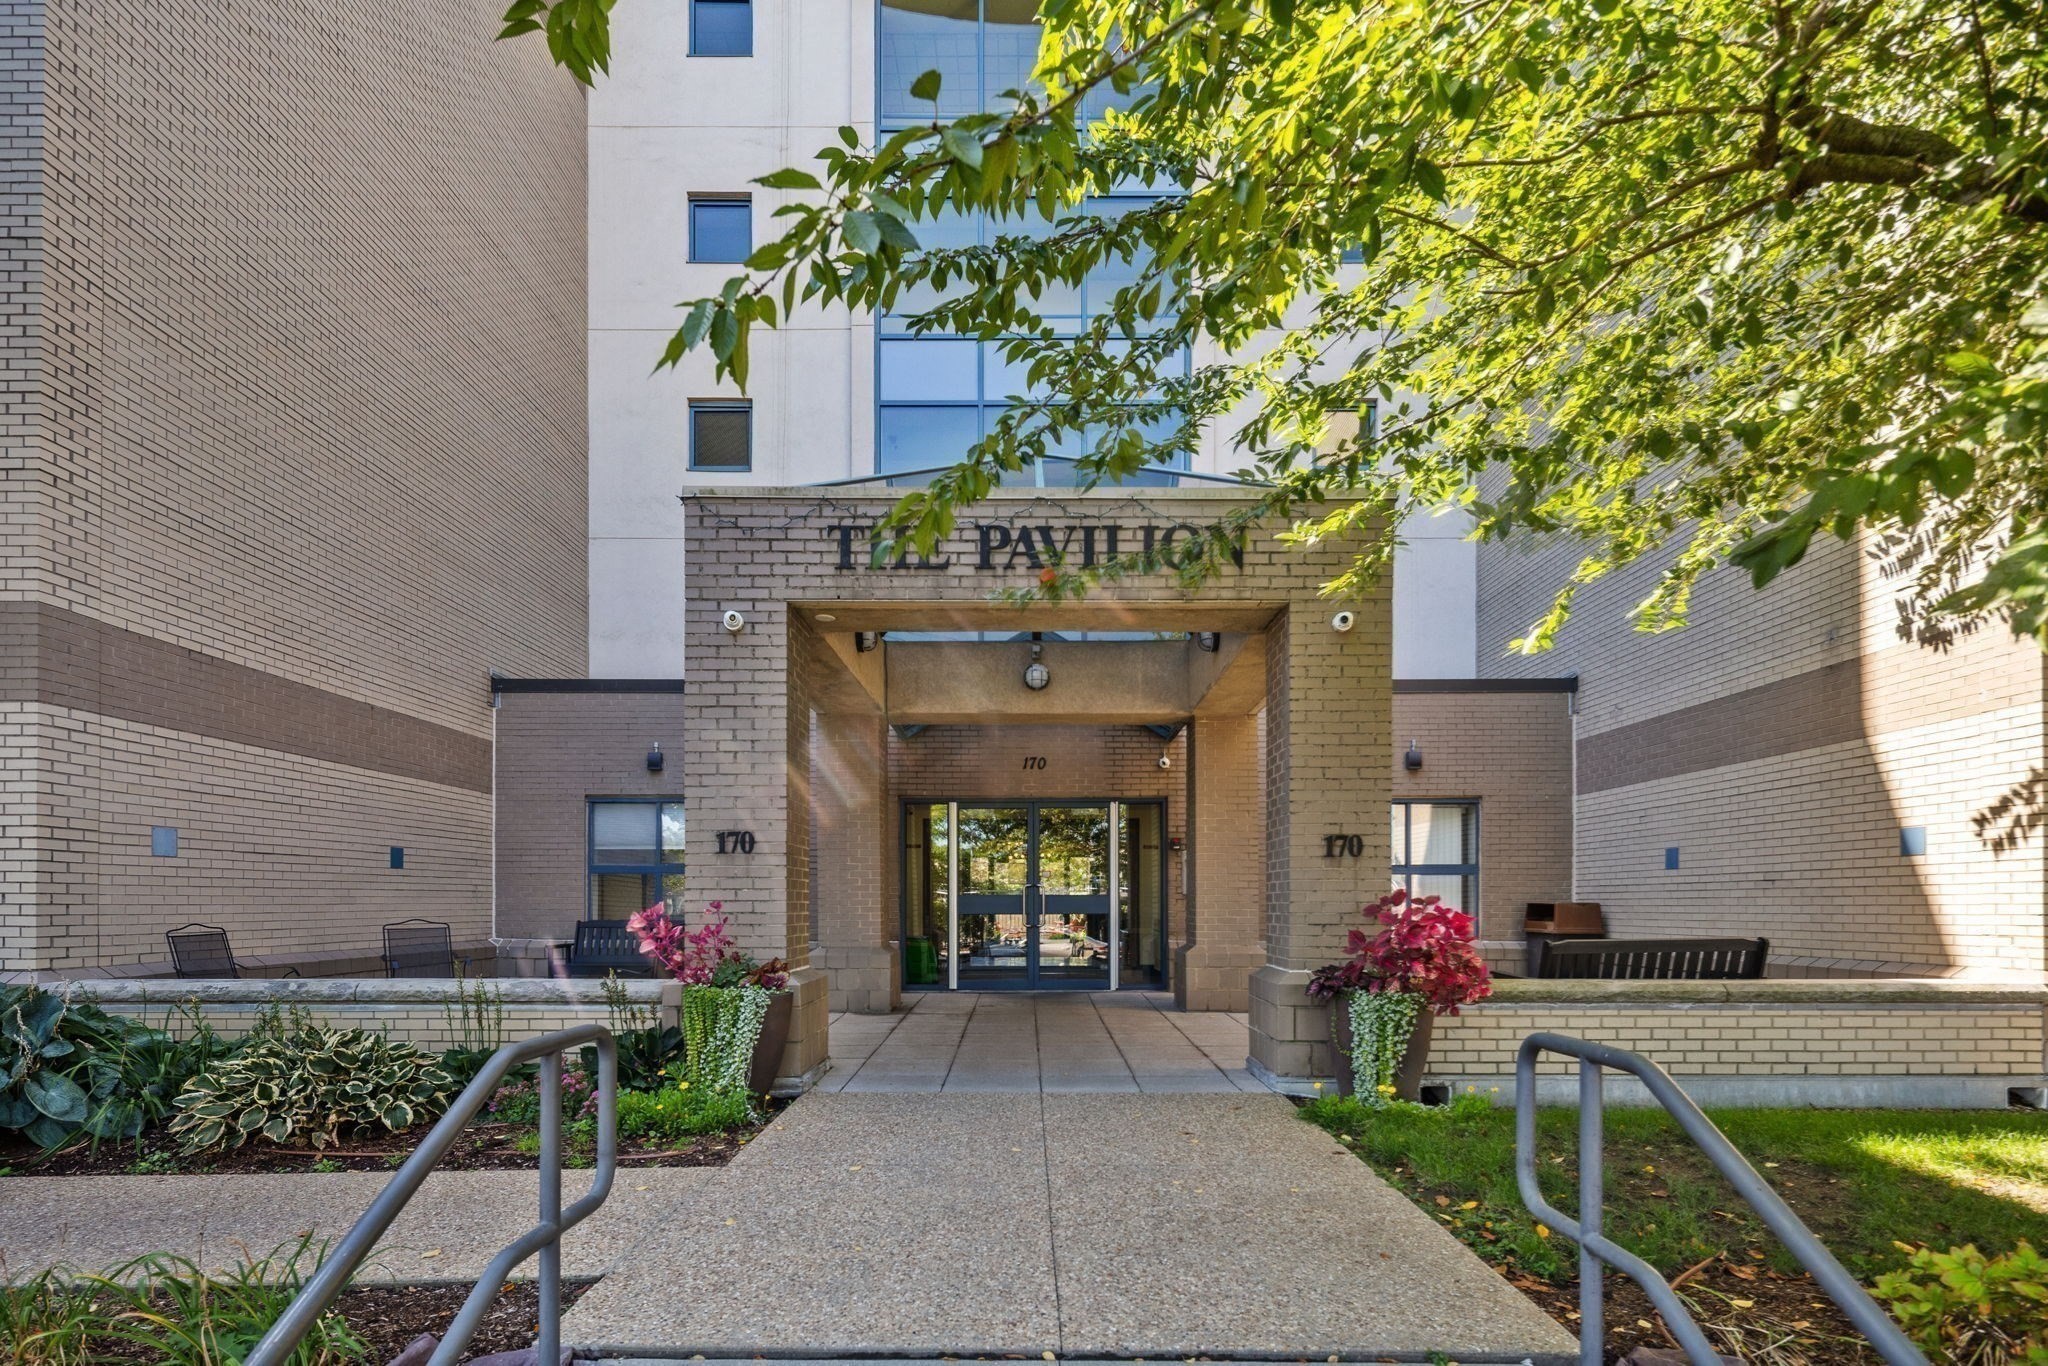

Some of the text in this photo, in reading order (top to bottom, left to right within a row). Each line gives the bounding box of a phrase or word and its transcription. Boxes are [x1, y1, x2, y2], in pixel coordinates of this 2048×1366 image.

[1022, 756, 1047, 770] 170
[715, 830, 755, 854] 170
[1322, 834, 1363, 858] 170
